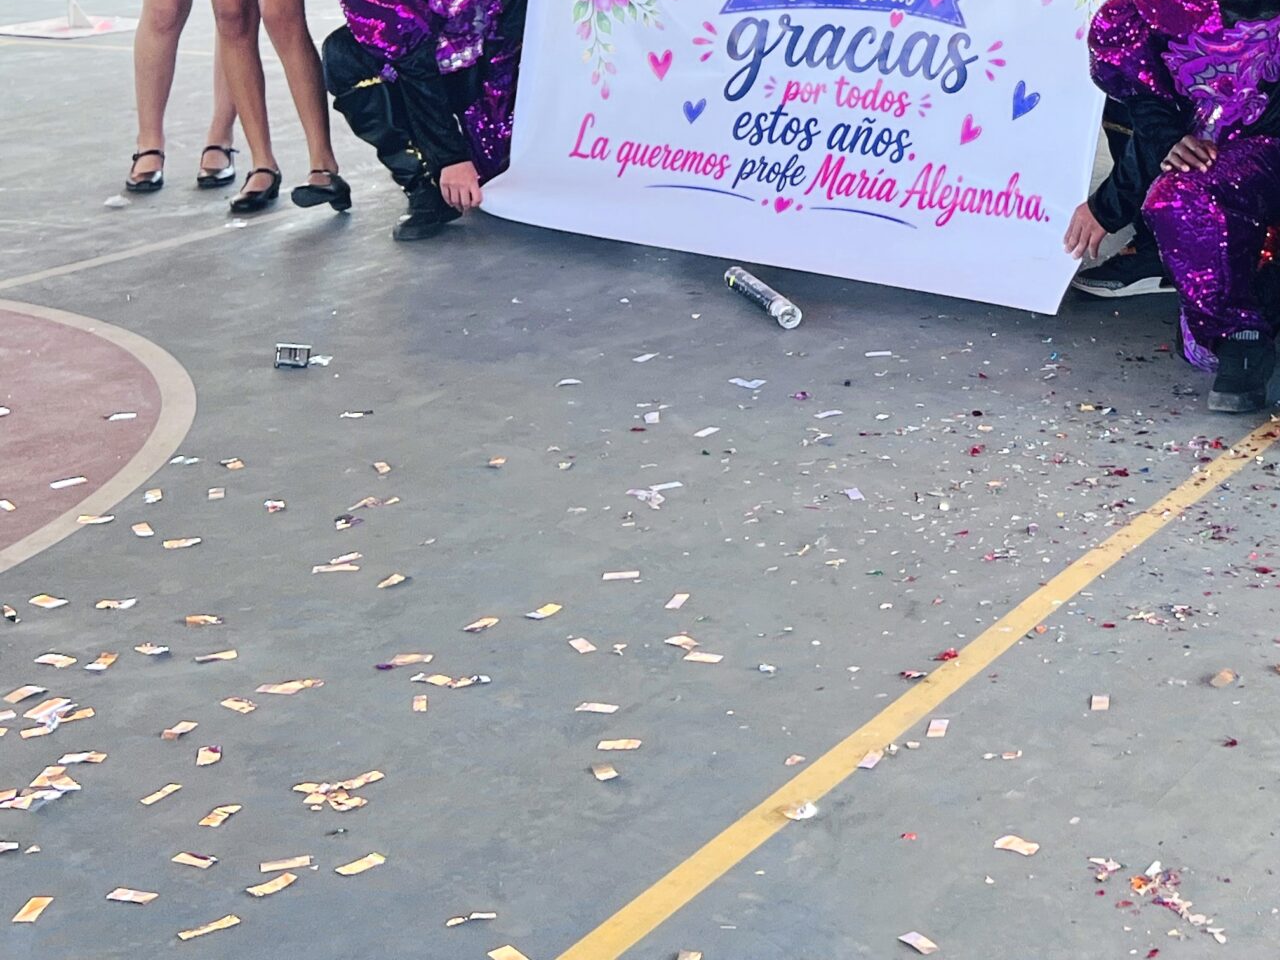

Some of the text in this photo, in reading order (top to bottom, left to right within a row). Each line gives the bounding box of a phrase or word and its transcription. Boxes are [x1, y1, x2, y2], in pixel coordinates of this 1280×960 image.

[723, 12, 979, 102] gracias
[783, 75, 912, 119] por todos
[568, 112, 1052, 227] La queremos profe María Alejandra.
[732, 105, 916, 164] estos años.
